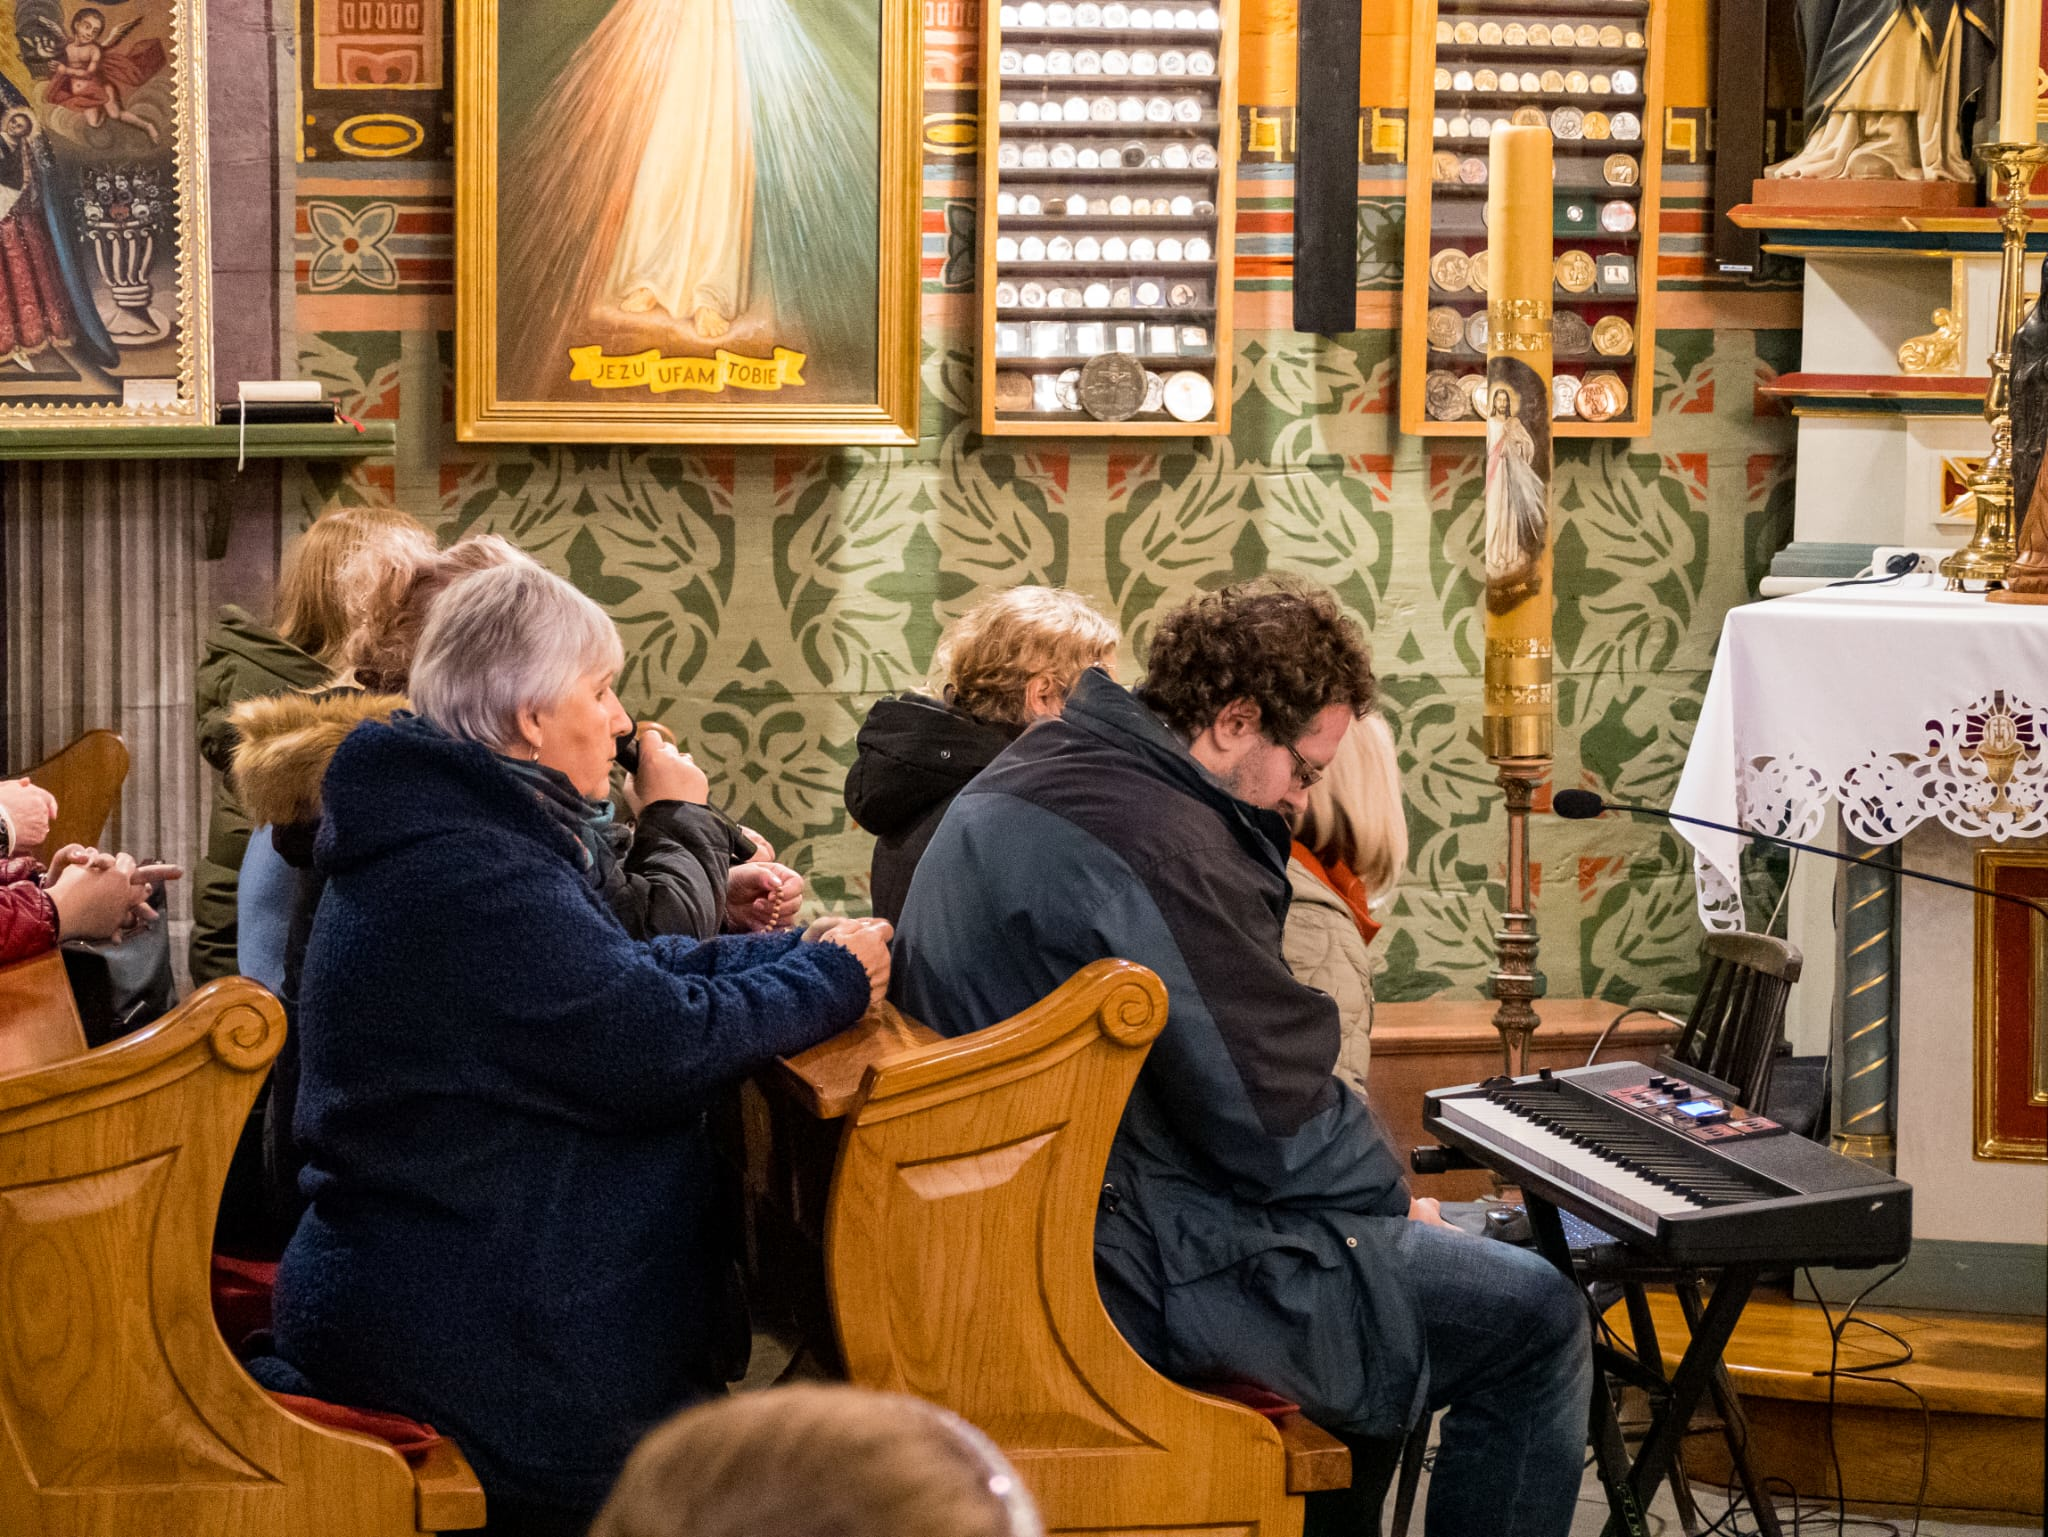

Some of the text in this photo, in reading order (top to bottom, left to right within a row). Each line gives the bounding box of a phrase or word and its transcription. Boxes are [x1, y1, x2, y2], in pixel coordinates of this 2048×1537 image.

[597, 362, 777, 385] JEZU UFAM TOBIE
